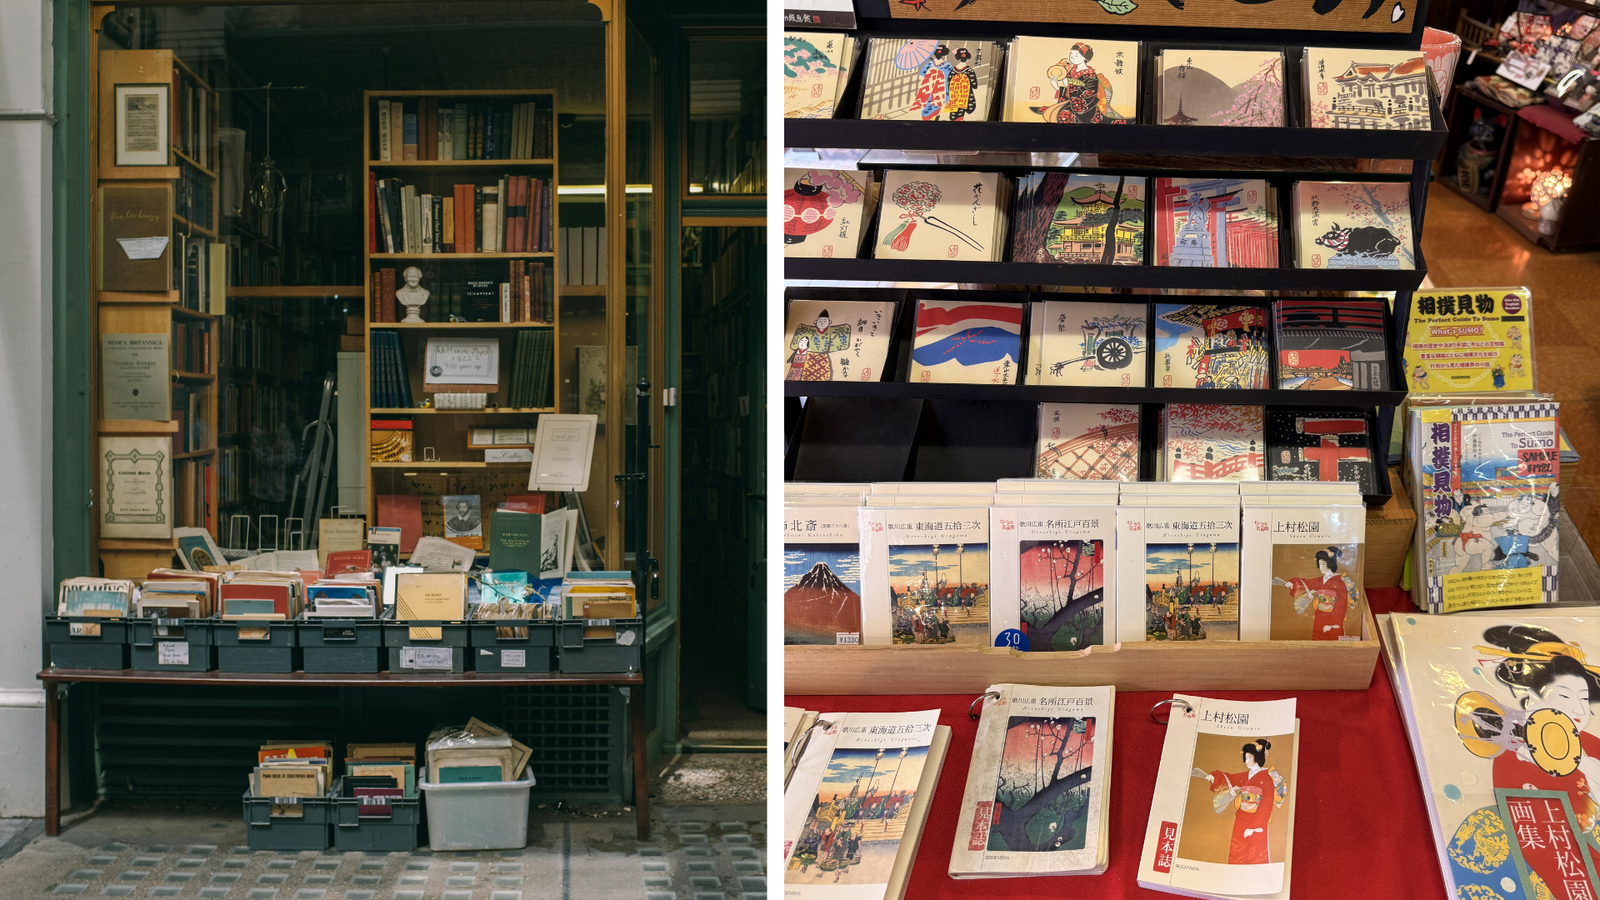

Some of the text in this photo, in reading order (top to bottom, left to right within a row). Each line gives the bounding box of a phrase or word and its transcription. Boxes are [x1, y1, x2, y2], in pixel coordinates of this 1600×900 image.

[1416, 294, 1495, 316] 相撲見物
[1430, 327, 1484, 336] What's SUMO?
[1519, 437, 1554, 449] Sumo
[1522, 451, 1558, 463] SAMPLE
[1431, 423, 1453, 518] 相撲見物
[1527, 463, 1553, 474] ¥1980
[915, 520, 982, 531] 東海道五拾三次
[1046, 519, 1100, 529] 名所江戸百景
[1172, 520, 1234, 531] 東海道五拾三次
[1273, 521, 1320, 533] 上村松園
[838, 636, 859, 644] ¥1330
[1038, 696, 1094, 706] 名所江戸百景
[1201, 709, 1250, 725] 上村松園
[868, 723, 931, 735] 東海道五拾三次
[1507, 801, 1547, 850] 画集
[1157, 827, 1176, 868] 見本誌
[1541, 799, 1594, 900] 上村松園
